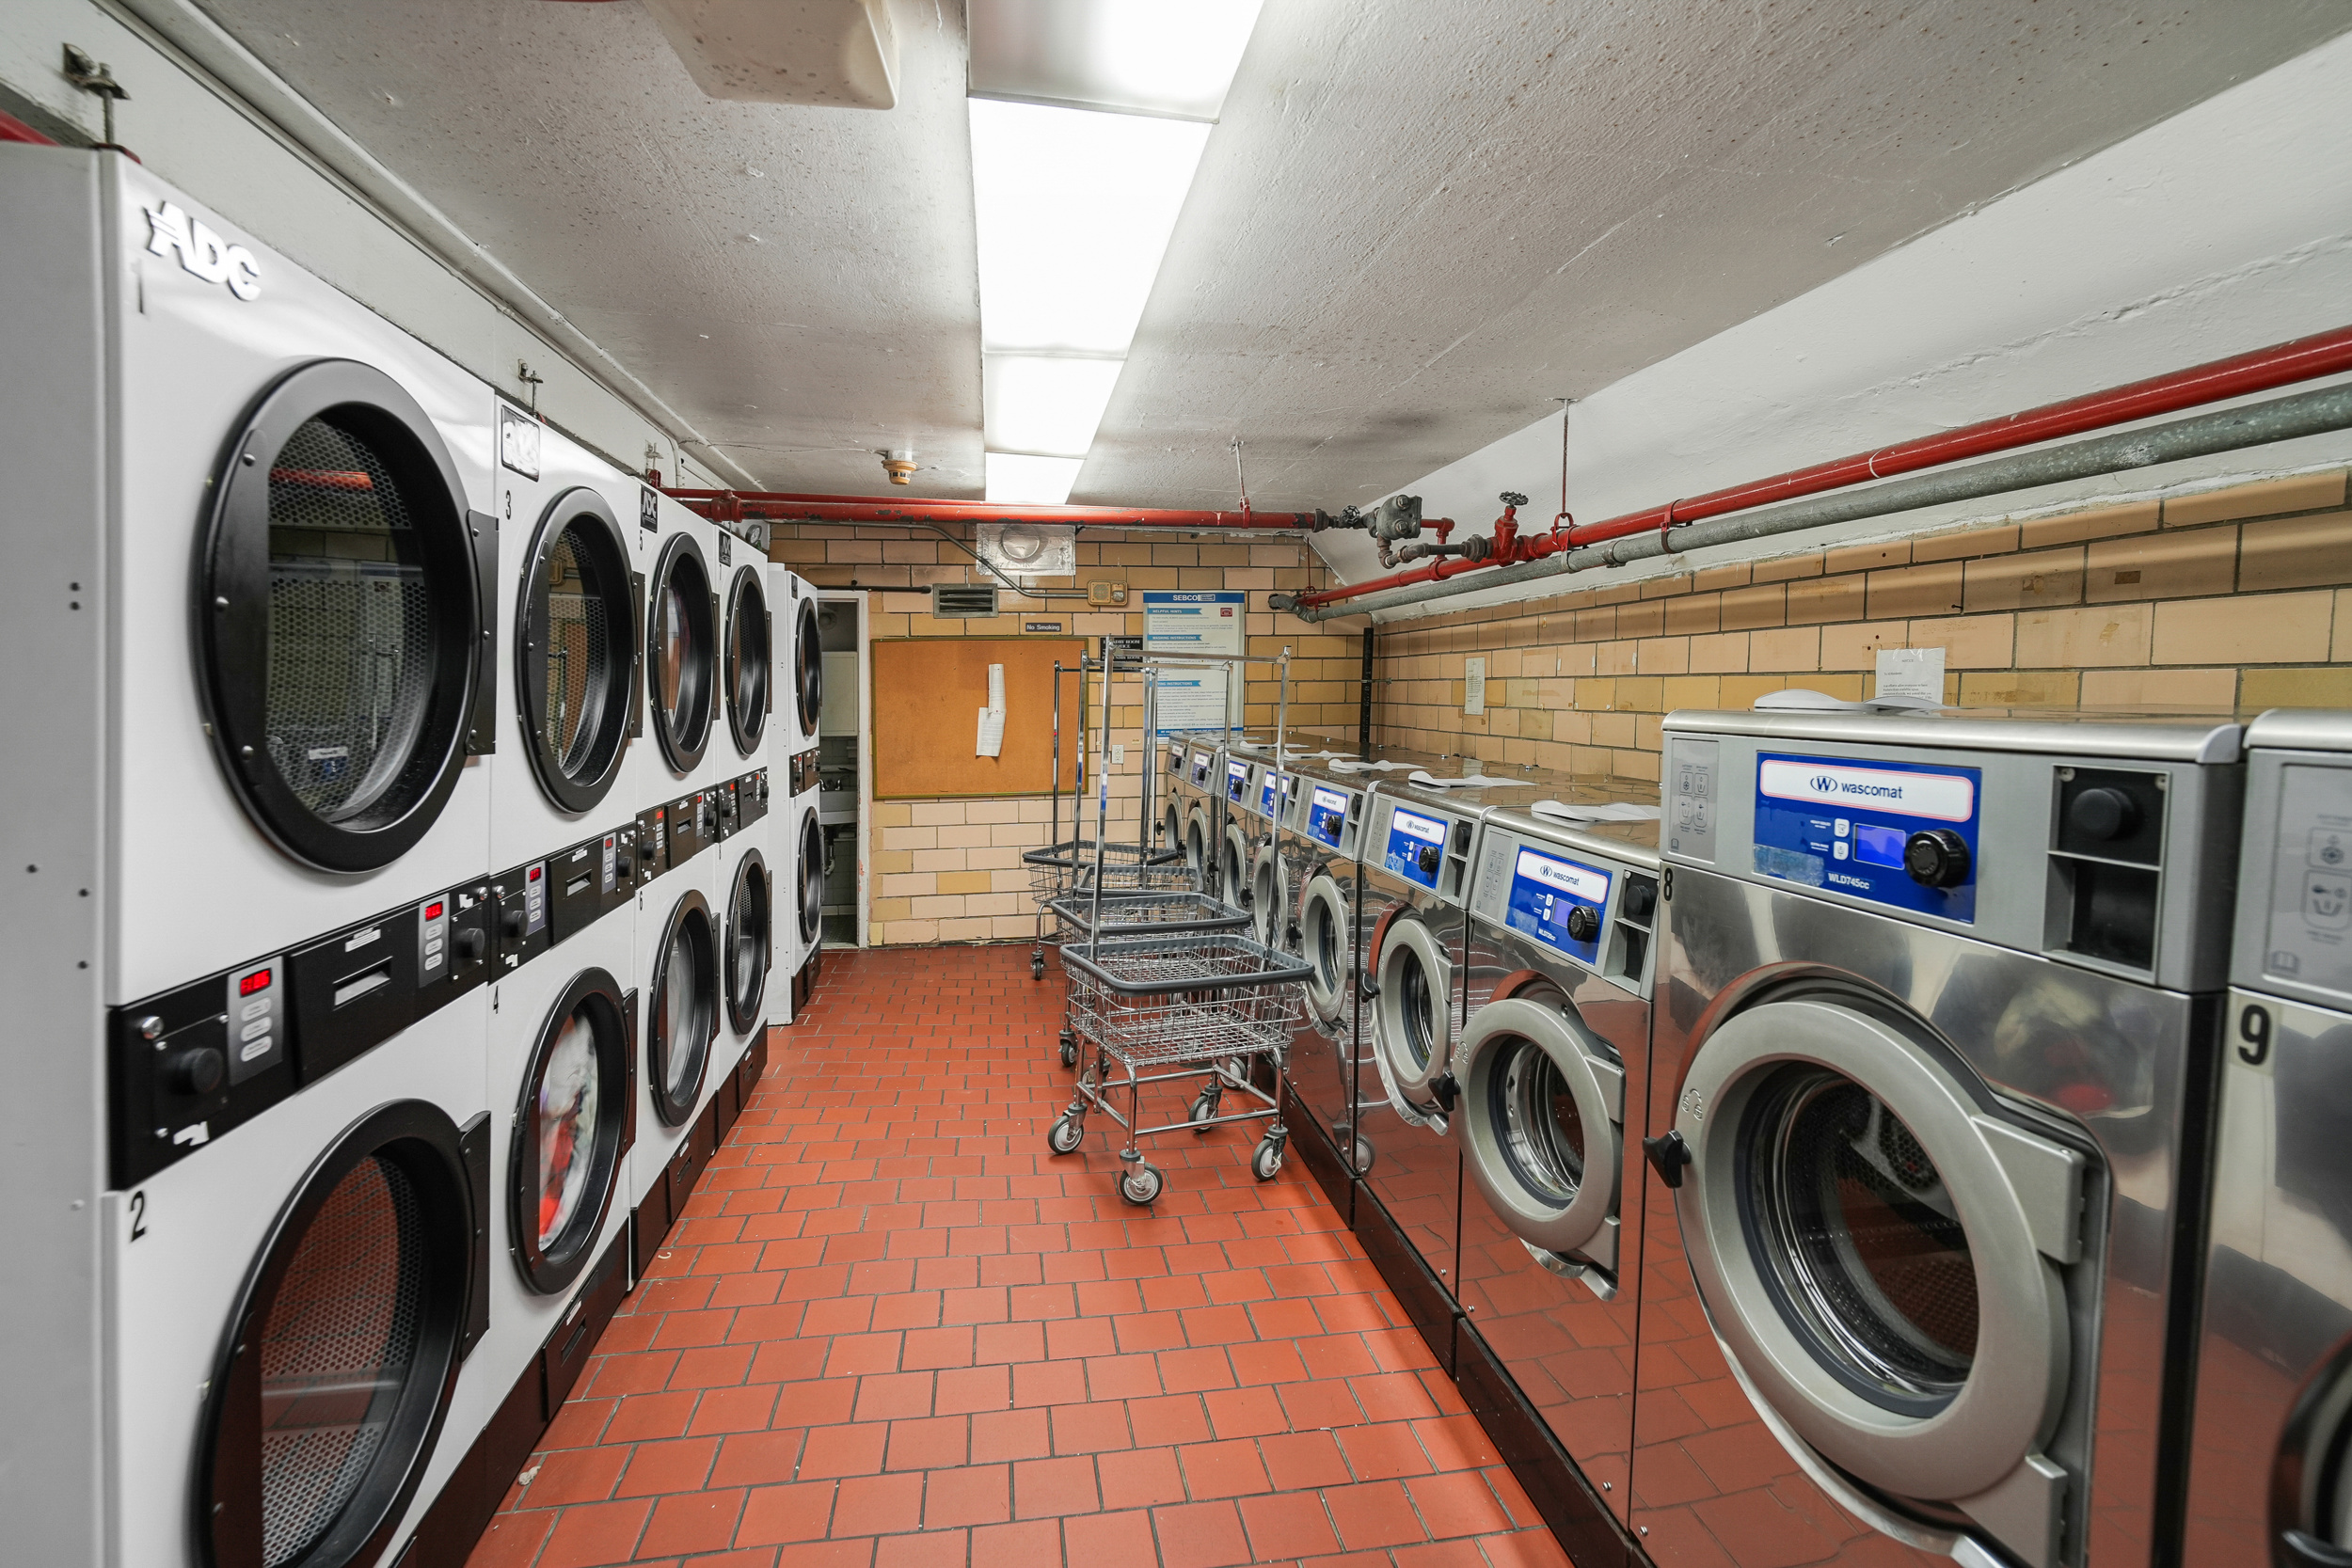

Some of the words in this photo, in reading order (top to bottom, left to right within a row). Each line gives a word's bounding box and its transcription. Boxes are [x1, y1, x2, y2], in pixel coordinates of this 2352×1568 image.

[142, 199, 262, 302] ADC
[505, 489, 512, 520] 3
[639, 529, 644, 551] 5
[1841, 783, 1903, 799] wascomat
[1552, 871, 1580, 885] wascomat
[1663, 867, 1674, 902] 8
[1828, 872, 1870, 890] WLD745cc
[639, 890, 644, 911] 6
[493, 985, 500, 1015] 4
[2237, 1004, 2272, 1066] 9
[130, 1190, 147, 1243] 2
